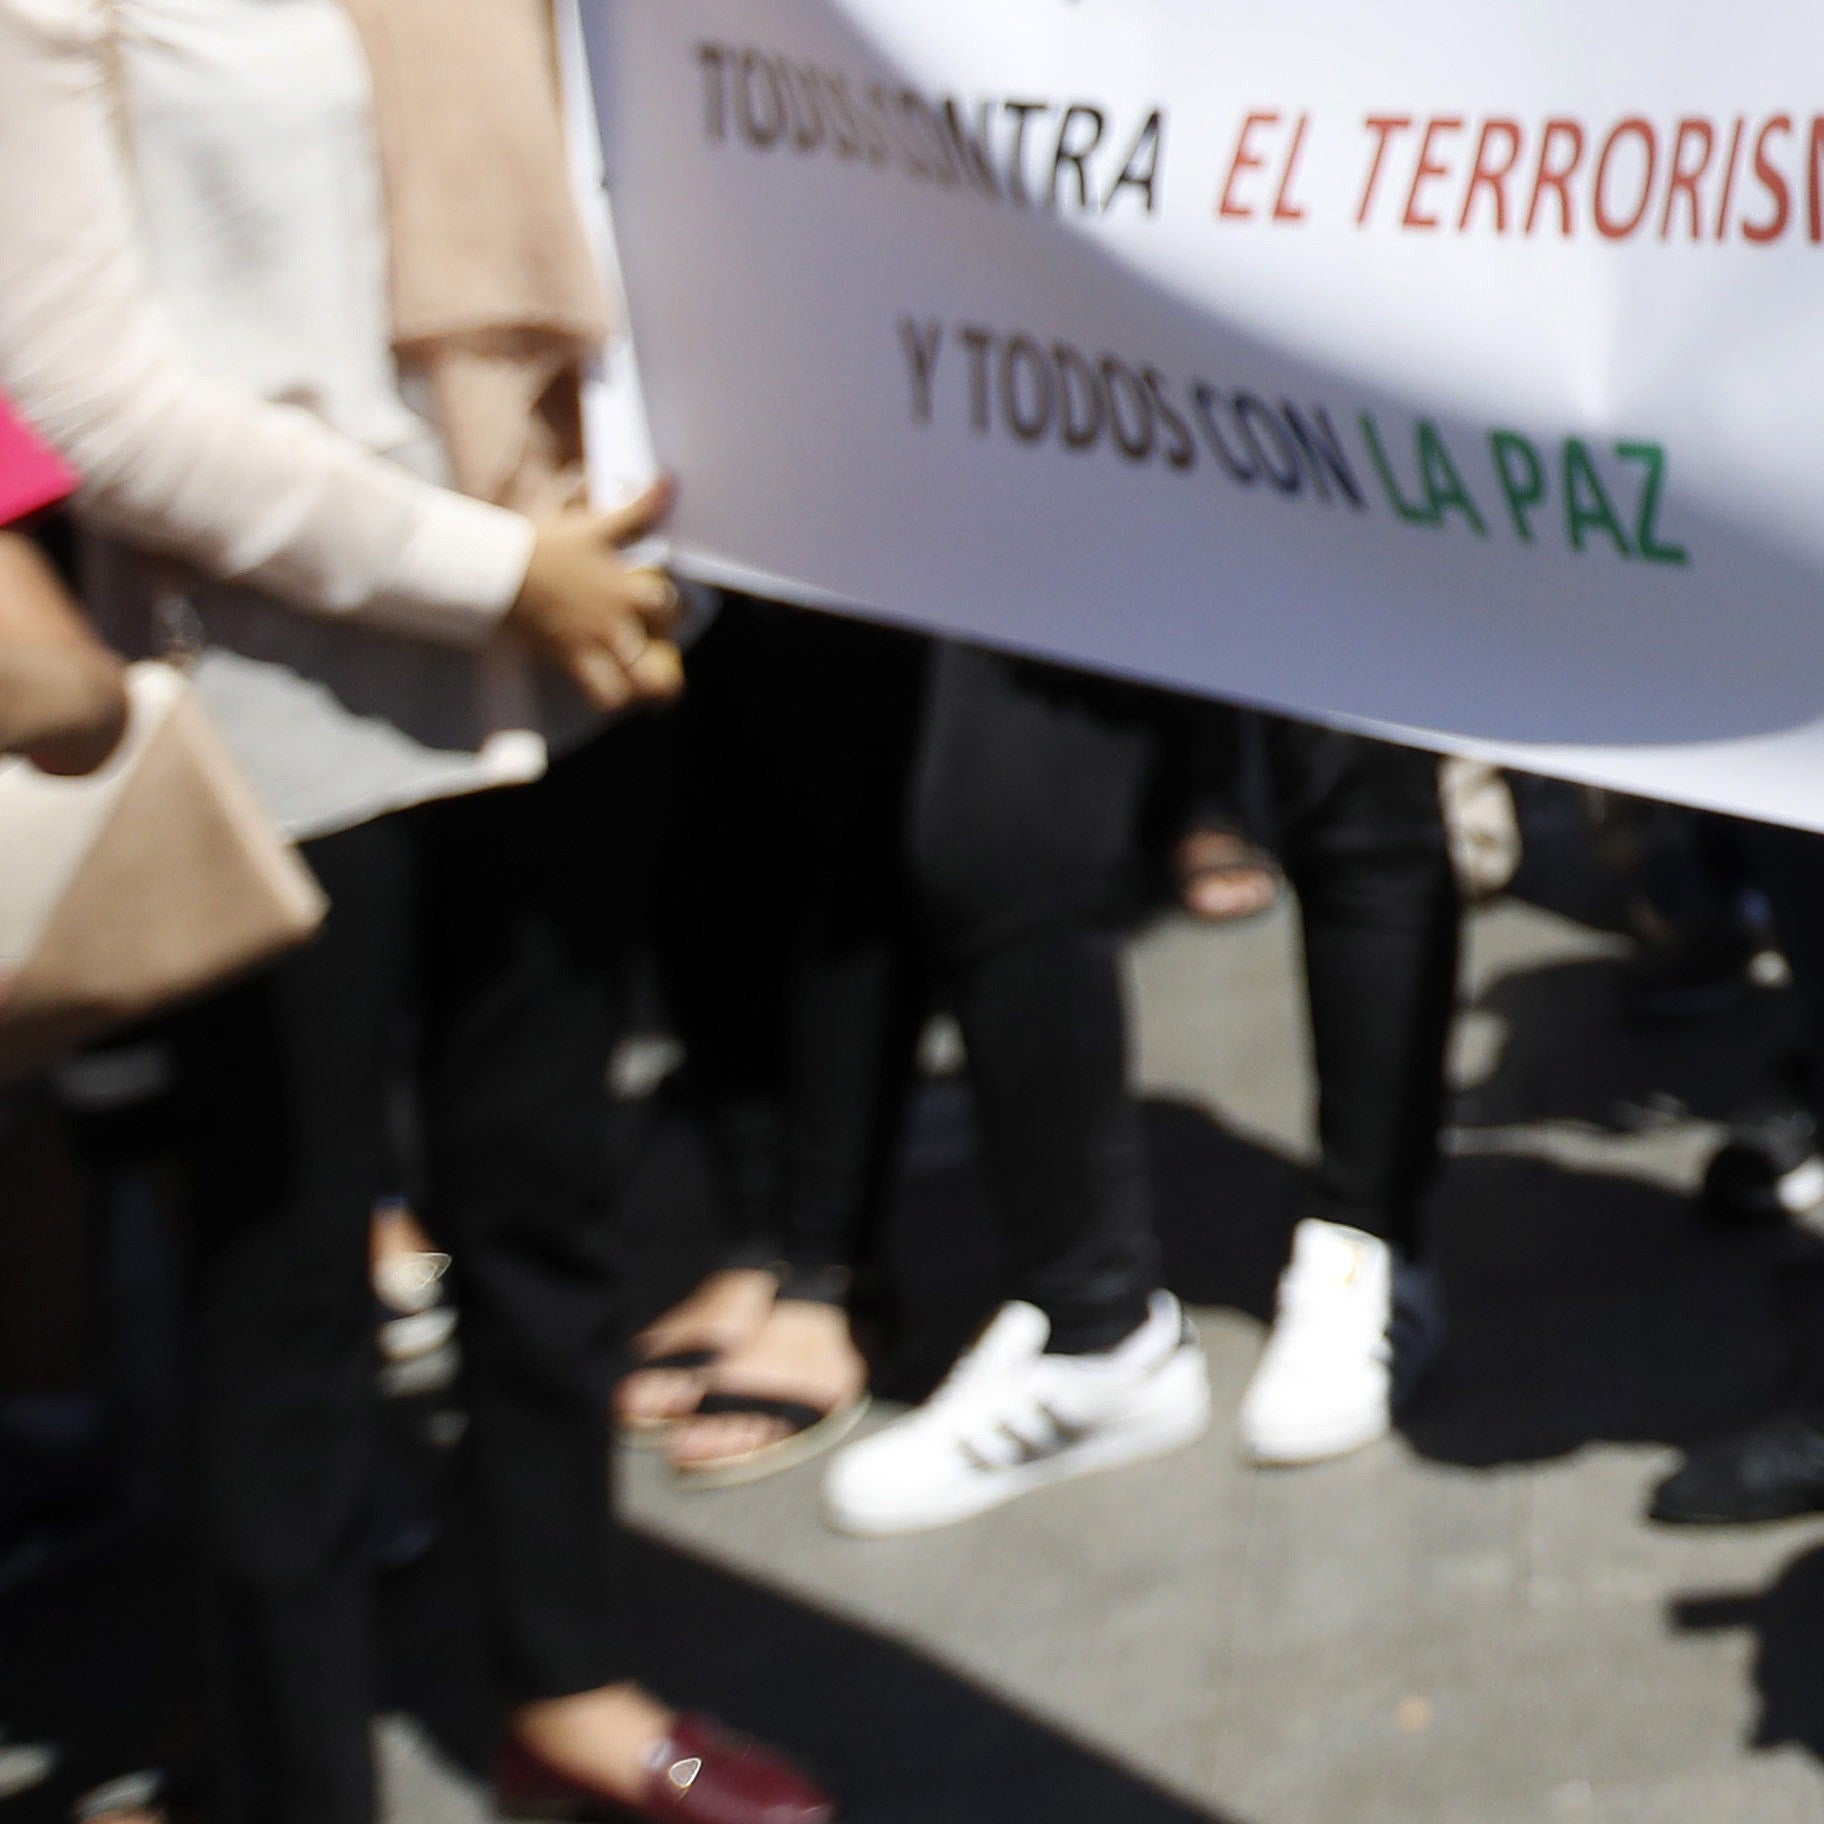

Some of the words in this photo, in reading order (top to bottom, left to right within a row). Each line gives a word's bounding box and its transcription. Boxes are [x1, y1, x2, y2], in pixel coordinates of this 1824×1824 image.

[1219, 111, 1309, 223] EL
[899, 310, 942, 428] Y
[957, 323, 1198, 472] TODOS
[1193, 379, 1369, 512] CON
[1357, 411, 1489, 539] LA
[1489, 428, 1692, 566] PAZ
